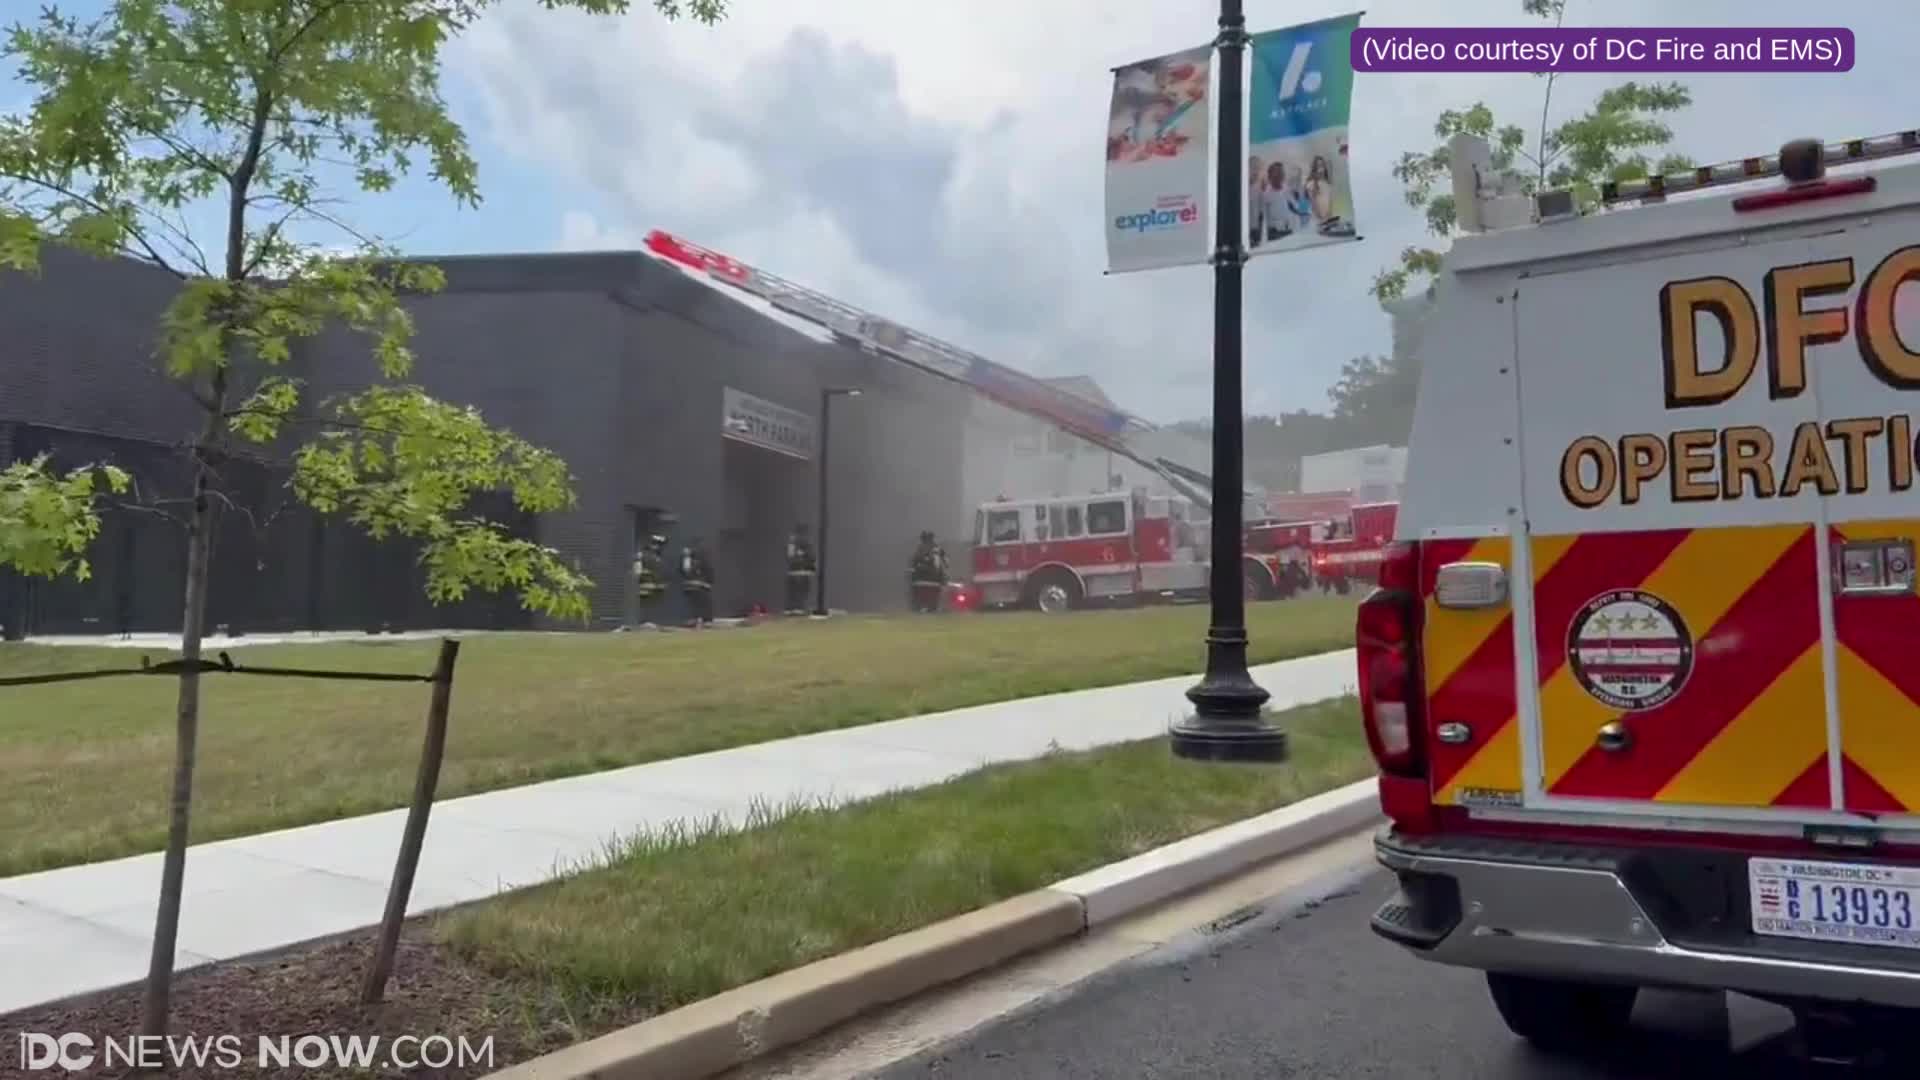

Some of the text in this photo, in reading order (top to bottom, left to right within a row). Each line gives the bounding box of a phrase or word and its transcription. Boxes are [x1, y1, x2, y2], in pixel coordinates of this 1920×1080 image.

[1115, 202, 1197, 232] explore!
[1559, 415, 1920, 509] OPERATI
[1811, 884, 1911, 929] 13933
